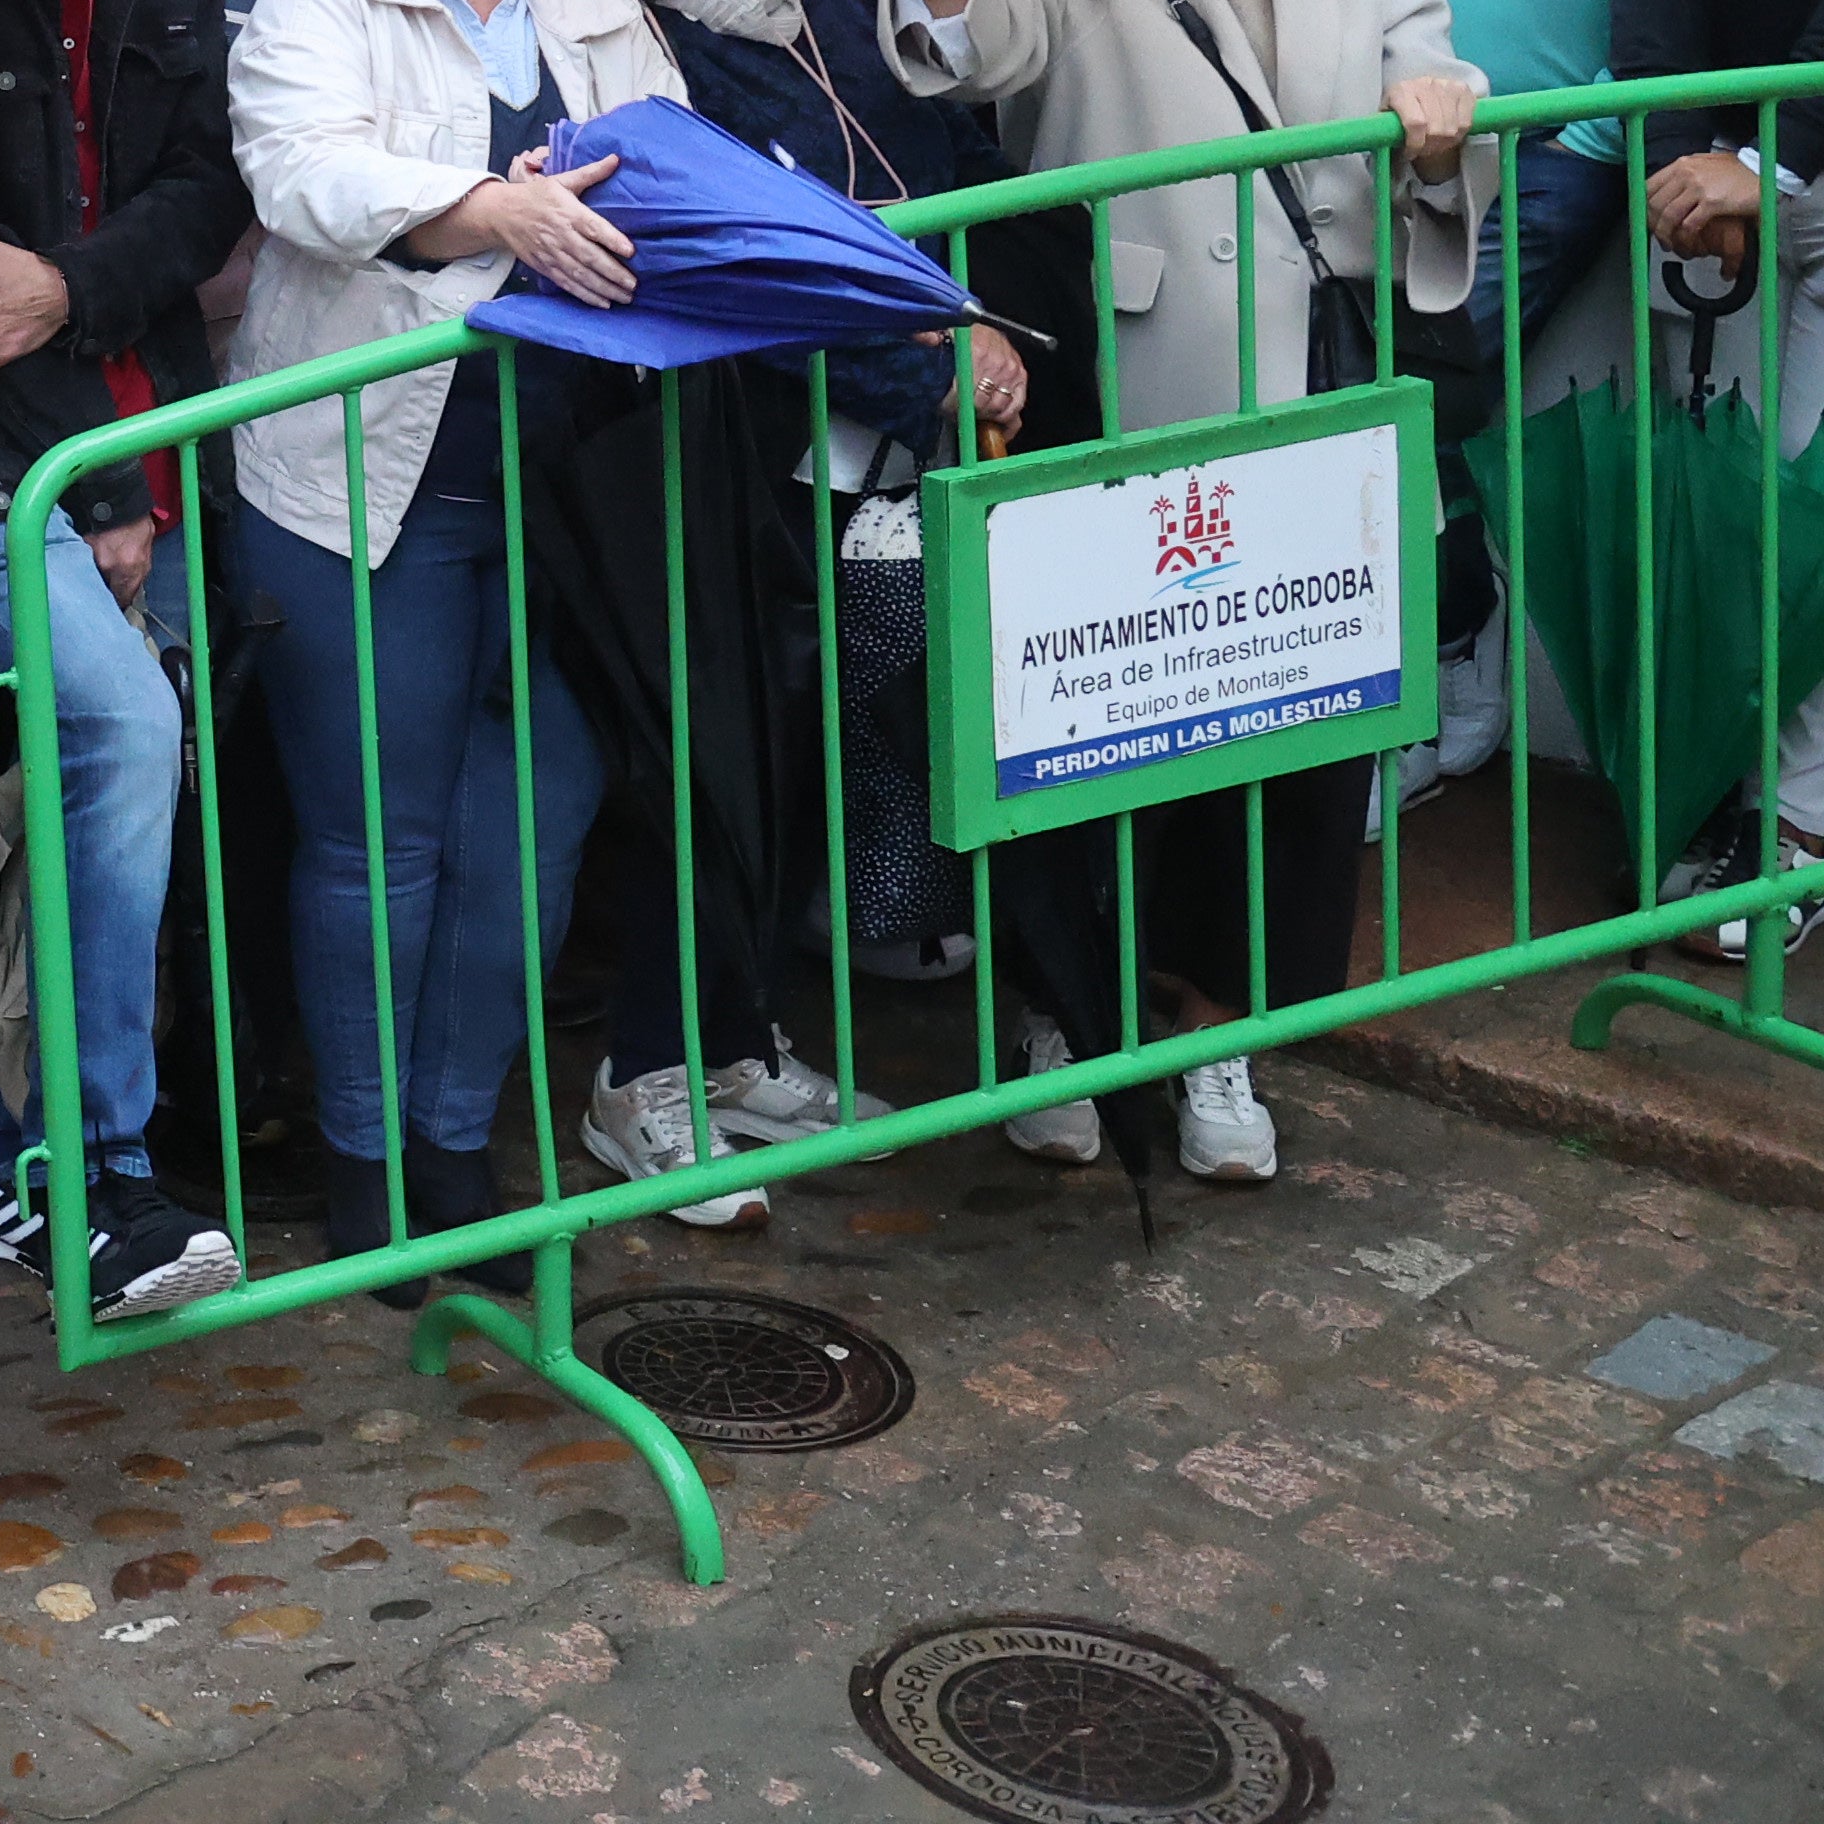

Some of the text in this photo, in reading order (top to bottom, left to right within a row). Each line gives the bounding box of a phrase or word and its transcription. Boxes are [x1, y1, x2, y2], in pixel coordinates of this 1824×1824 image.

[1021, 564, 1374, 670] AYUNTAMIENTO DE CÓRDOBA
[1050, 616, 1362, 702] Área de Infraestructuras
[1035, 689, 1362, 779] PERDONEN LAS MOLESTIAS
[1106, 663, 1309, 725] Equipo de Montajes
[895, 1637, 987, 1704] SERVICIO
[993, 1634, 1190, 1694] MUNICIPAL
